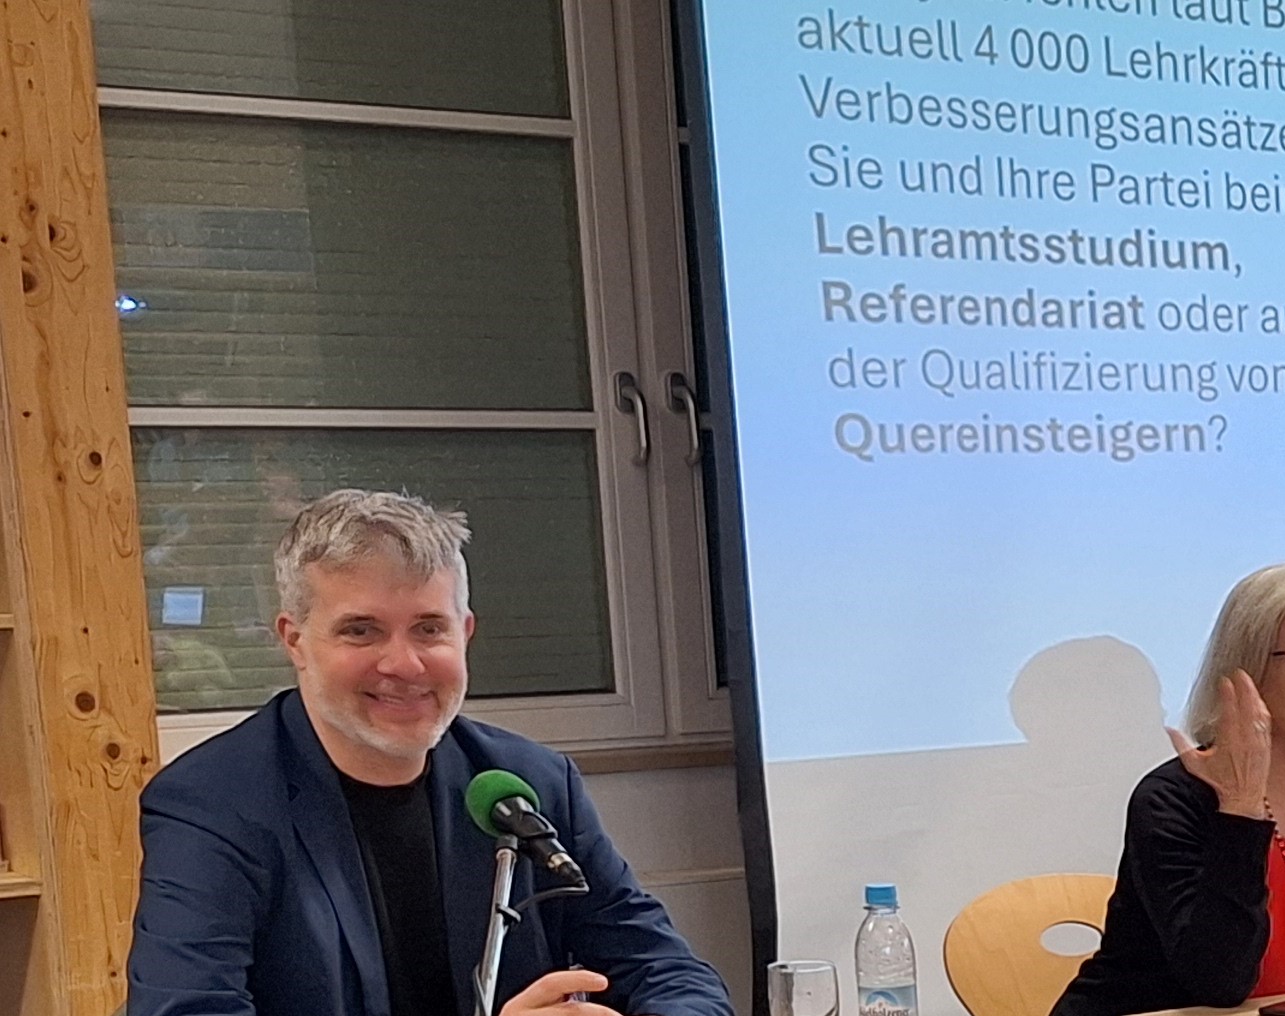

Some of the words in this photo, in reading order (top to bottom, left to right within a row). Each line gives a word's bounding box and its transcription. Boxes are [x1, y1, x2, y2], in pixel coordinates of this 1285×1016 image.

[797, 7, 964, 64] aktuell
[973, 23, 999, 67] 4
[1010, 27, 1090, 74] 000
[808, 143, 884, 191] Sie
[899, 154, 984, 198] und
[996, 155, 1077, 203] Ihre
[1090, 162, 1213, 212] Partei
[814, 211, 1243, 280] Lehramtsstudium,
[821, 280, 1147, 333] Referendariat
[1157, 292, 1251, 335] oder
[828, 346, 909, 391] der
[921, 348, 1220, 404] Qualifizierung
[834, 412, 1229, 464] Quereinsteigern?
